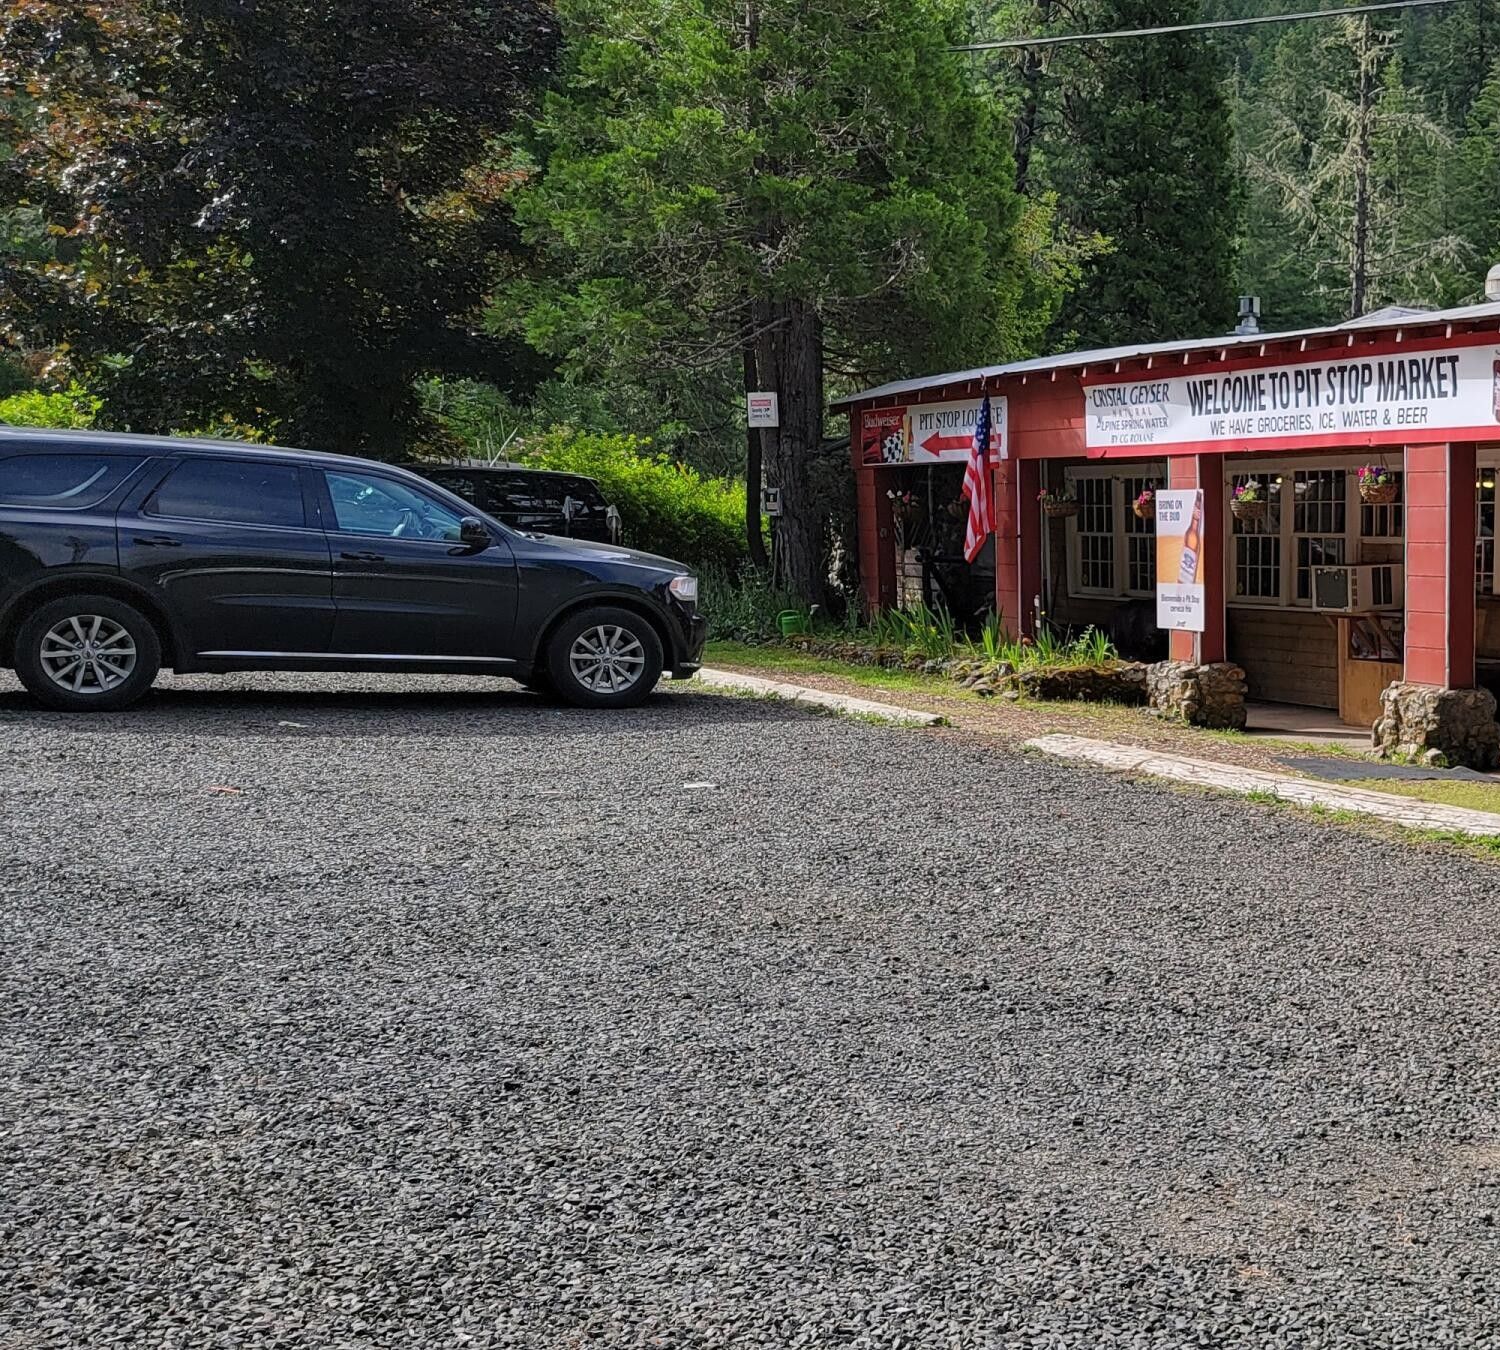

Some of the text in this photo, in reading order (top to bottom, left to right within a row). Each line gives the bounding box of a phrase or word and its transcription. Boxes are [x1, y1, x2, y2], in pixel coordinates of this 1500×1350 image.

[1130, 383, 1170, 405] GEYSER
[1187, 355, 1459, 416] WELCOME TO PIT STOP MARKET
[864, 414, 900, 428] Budweiser
[919, 406, 1003, 430] PIT STOP LOUE
[1209, 406, 1428, 436] WE HAVE GROCERIES, ICE, WATER & BEER
